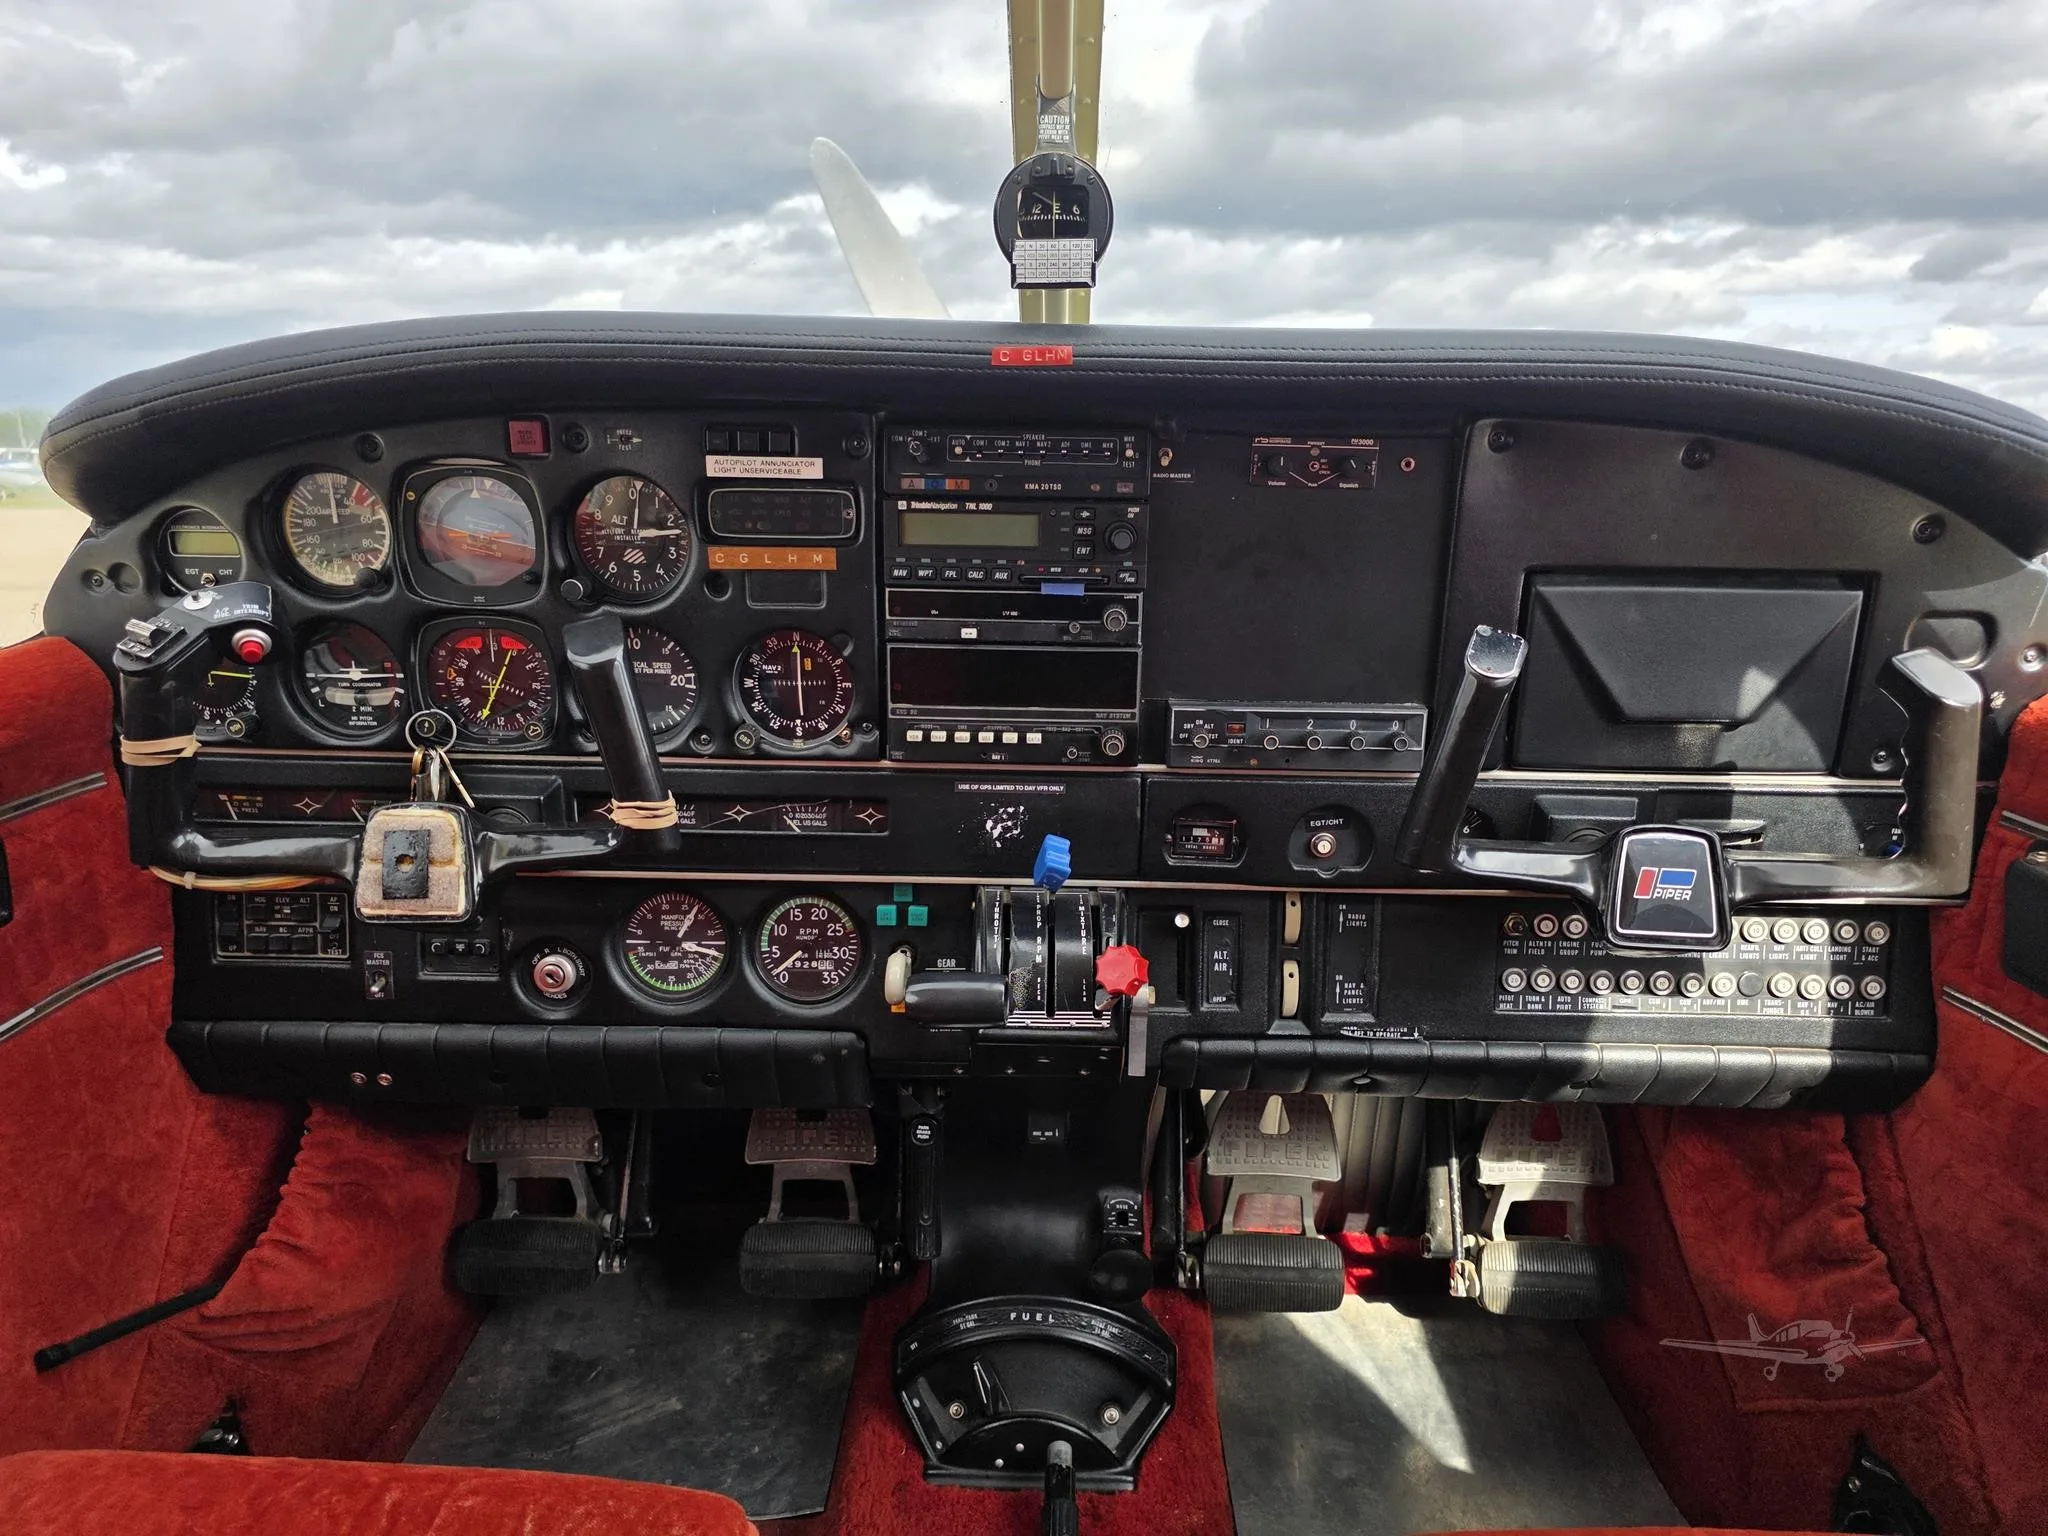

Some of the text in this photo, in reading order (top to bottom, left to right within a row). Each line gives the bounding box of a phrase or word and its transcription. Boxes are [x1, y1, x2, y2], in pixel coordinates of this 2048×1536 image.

[1040, 115, 1070, 124] CAUTION
[1032, 203, 1080, 214] 12 6
[714, 459, 815, 468] AUTOPILOT ANNUNCIATOR
[343, 498, 355, 506] 40
[611, 515, 628, 526] ALT
[303, 506, 373, 562] 60 80 100 160 180 200
[594, 488, 677, 581] 0 2 3 4 5 6 7 8 9
[1076, 547, 1091, 555] ENT
[893, 569, 908, 577] NAV
[945, 570, 957, 578] FPL
[968, 571, 984, 579] CALC
[627, 638, 641, 649] 10
[670, 675, 685, 686] 20
[1307, 719, 1398, 731] 2 0 0
[739, 735, 750, 744] OBS
[1310, 818, 1344, 827] EGT/CHT
[1463, 825, 1470, 834] 6
[1652, 888, 1692, 901] PIPER
[1078, 905, 1087, 955] MIXTURE
[772, 908, 849, 984] 5 10 15 20 25 30 35 0
[1503, 939, 1519, 947] PITCH
[1559, 940, 1580, 948] ENGINE
[1213, 950, 1229, 960] ALT.
[1559, 948, 1579, 956] GROUP
[1739, 952, 1760, 960] LIGHTS
[1800, 953, 1817, 961] LIGHT
[1830, 953, 1847, 961] LIGHT
[531, 947, 585, 976] OFF BOTH START
[937, 958, 956, 967] GEAR
[1214, 962, 1227, 972] AIR
[1557, 995, 1571, 1003] AUTO
[1527, 1002, 1542, 1010] BANK
[1582, 1002, 1605, 1010] SYSTEM
[1854, 1008, 1875, 1016] BLOWER
[1010, 1312, 1054, 1322] FUEL
